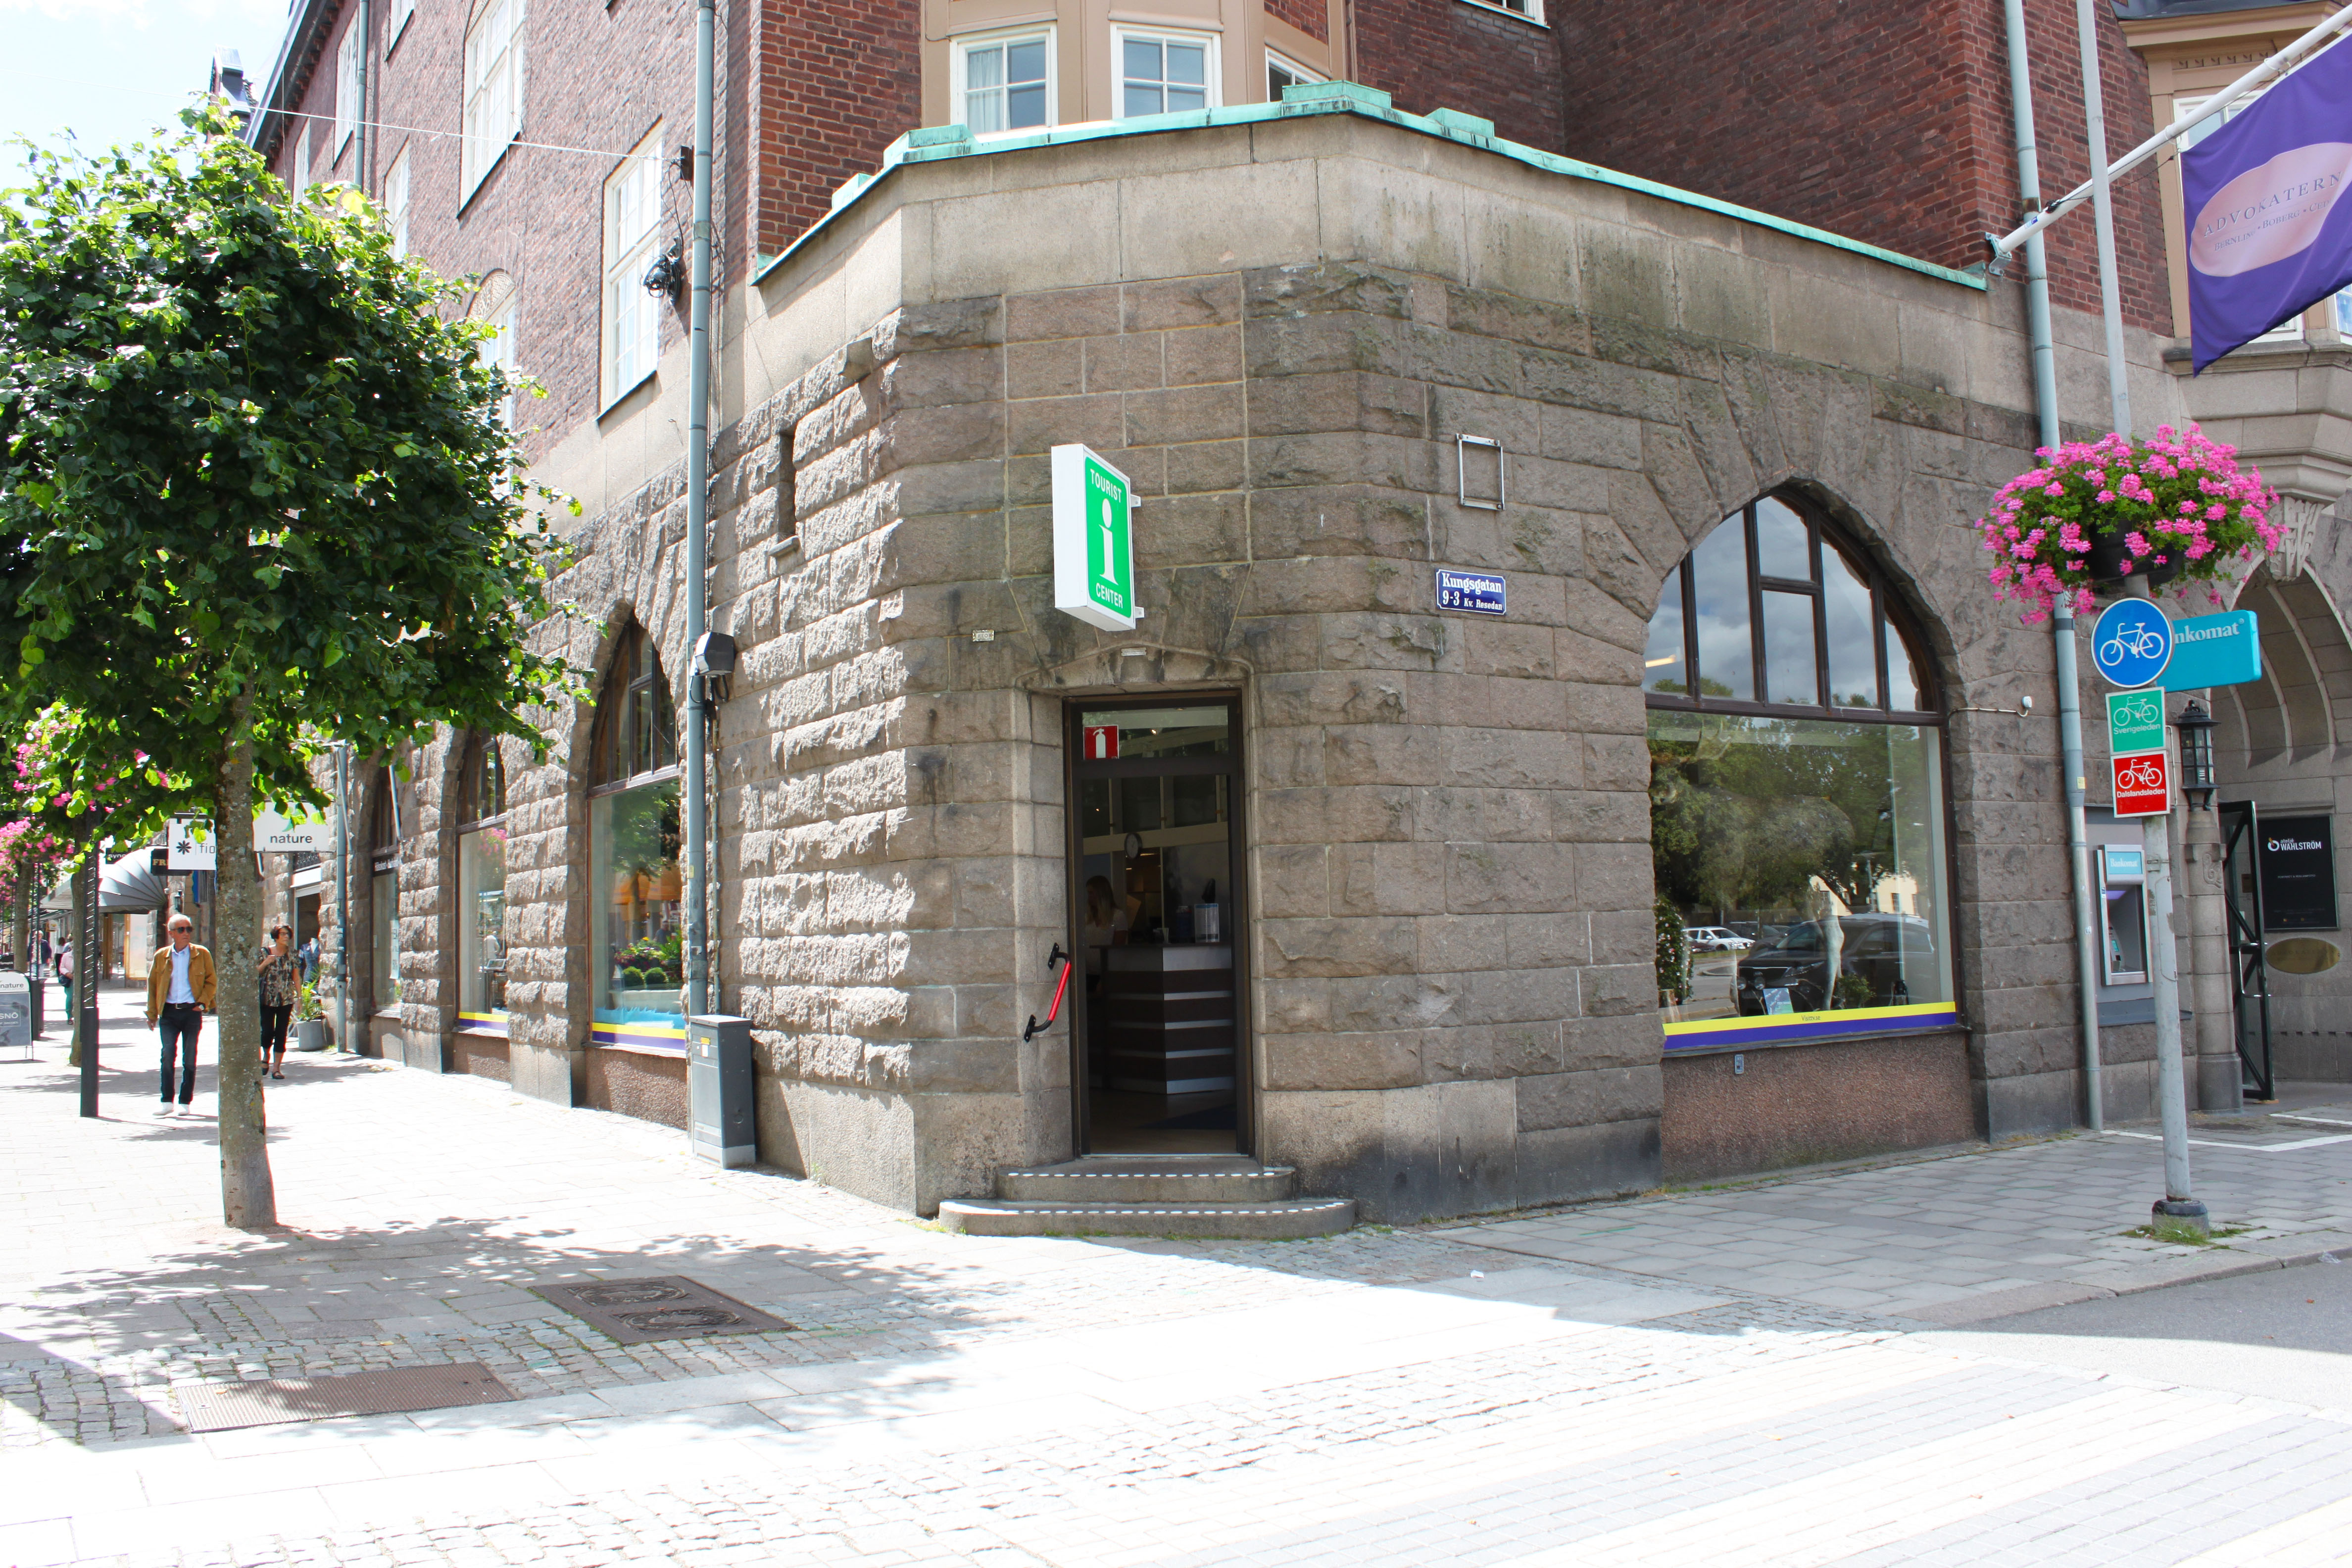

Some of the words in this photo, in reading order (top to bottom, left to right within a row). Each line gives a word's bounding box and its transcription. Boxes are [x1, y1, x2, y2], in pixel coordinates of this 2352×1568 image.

[2262, 210, 2301, 229] BOBERG
[1090, 469, 1122, 503] TOURIST
[1442, 573, 1502, 594] Kungsgatan
[1096, 583, 1123, 609] CENTER
[1442, 590, 1460, 606] 9-3
[1464, 598, 1473, 607] Kv.
[1476, 599, 1503, 610] Resedan
[2113, 724, 2161, 735] Sverigeleden
[2117, 788, 2165, 798] Dalslandsleden
[270, 834, 312, 843] nature
[2280, 840, 2322, 851] WAHLSTRÖM
[2110, 858, 2138, 867] Bankomat
